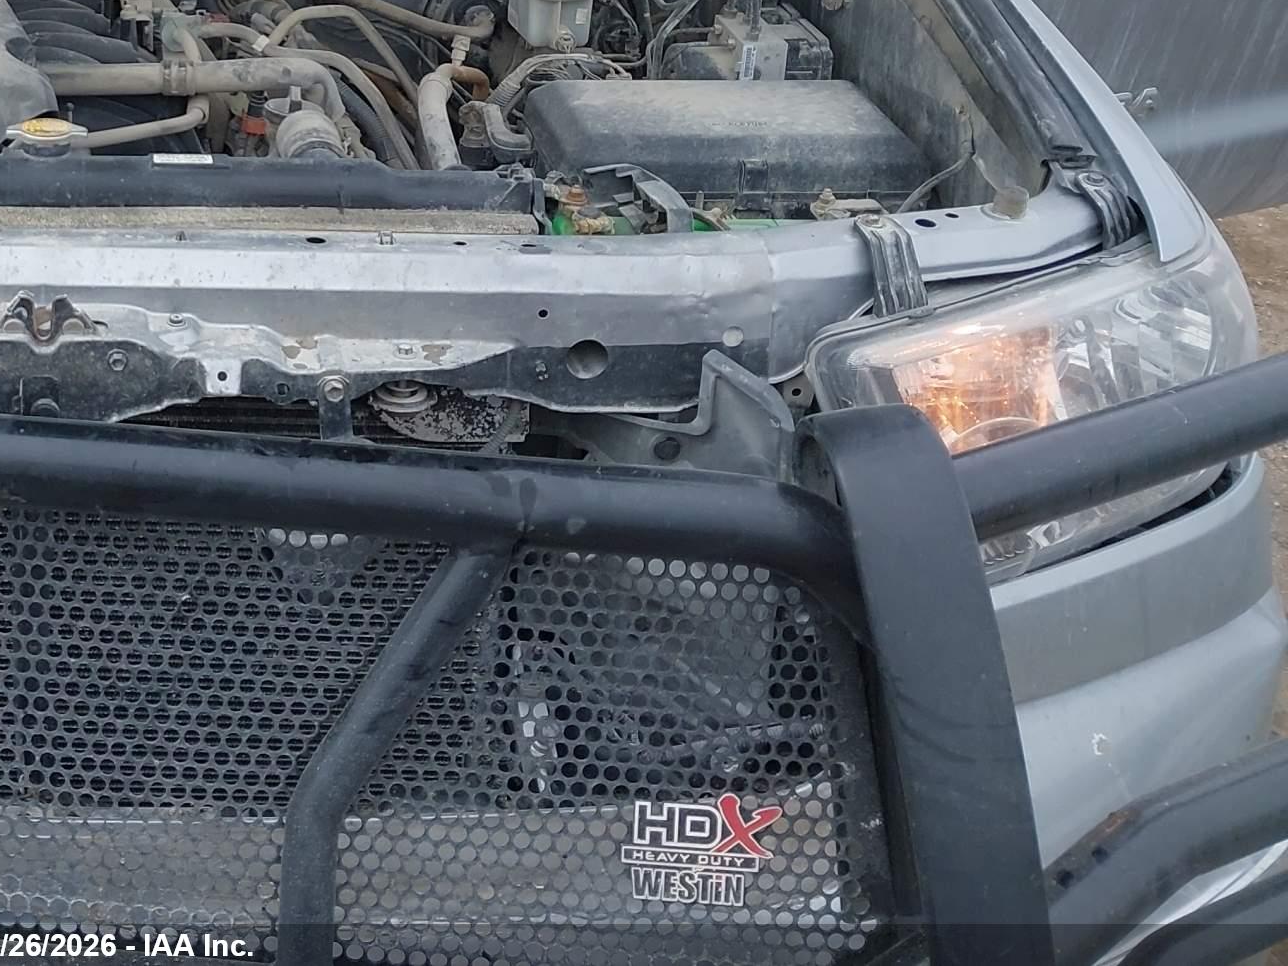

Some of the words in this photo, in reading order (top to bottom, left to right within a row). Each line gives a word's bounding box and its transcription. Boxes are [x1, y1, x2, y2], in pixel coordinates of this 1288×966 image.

[633, 793, 783, 859] HDX
[631, 849, 690, 863] HEAVY
[697, 854, 745, 867] DUTY
